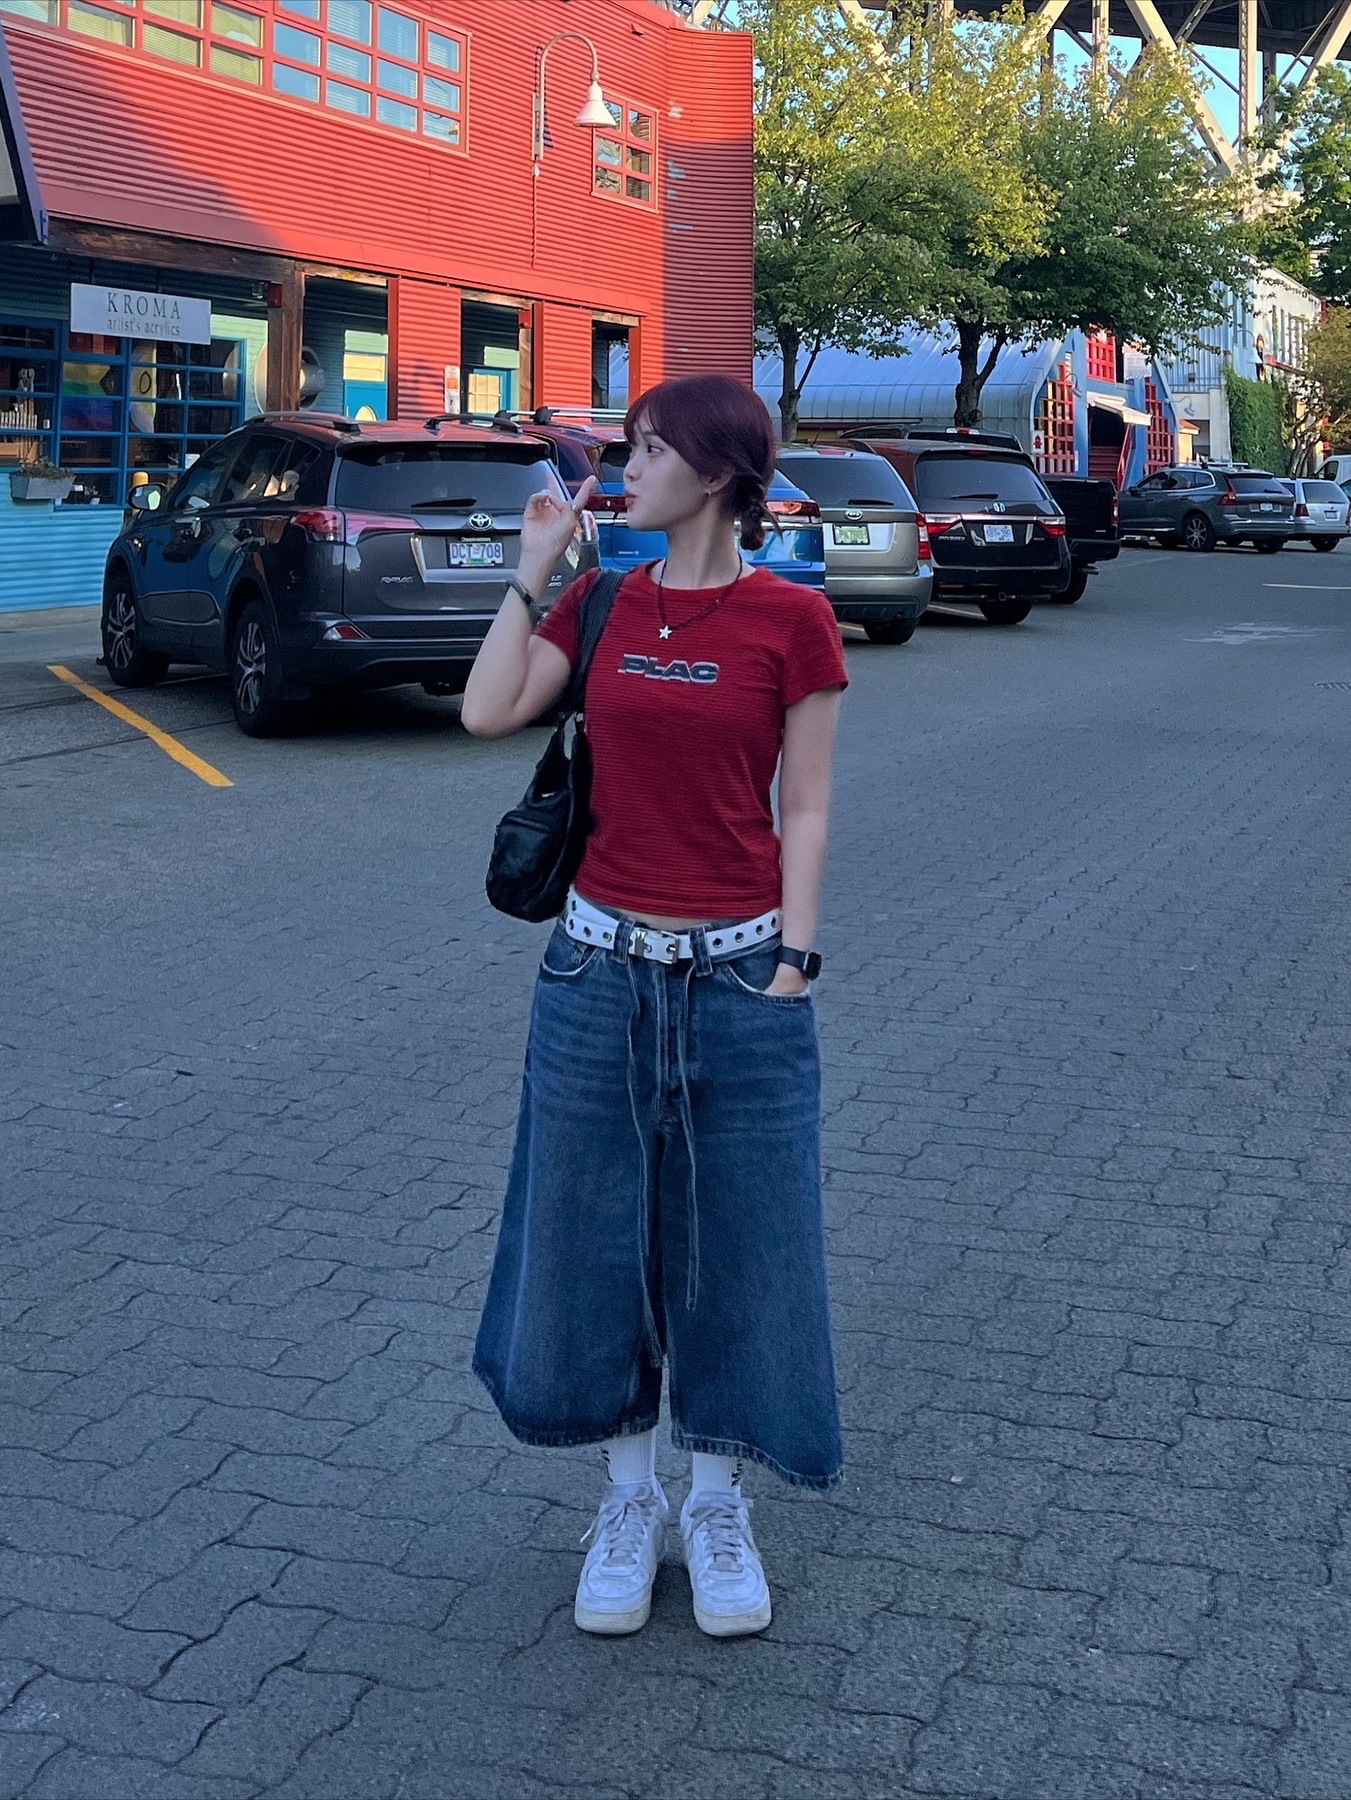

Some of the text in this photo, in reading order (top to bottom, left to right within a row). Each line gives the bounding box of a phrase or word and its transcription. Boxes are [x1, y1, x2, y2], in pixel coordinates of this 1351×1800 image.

[107, 292, 180, 319] KROMA
[107, 317, 180, 336] artist's acrylics
[452, 544, 501, 559] DCT 708
